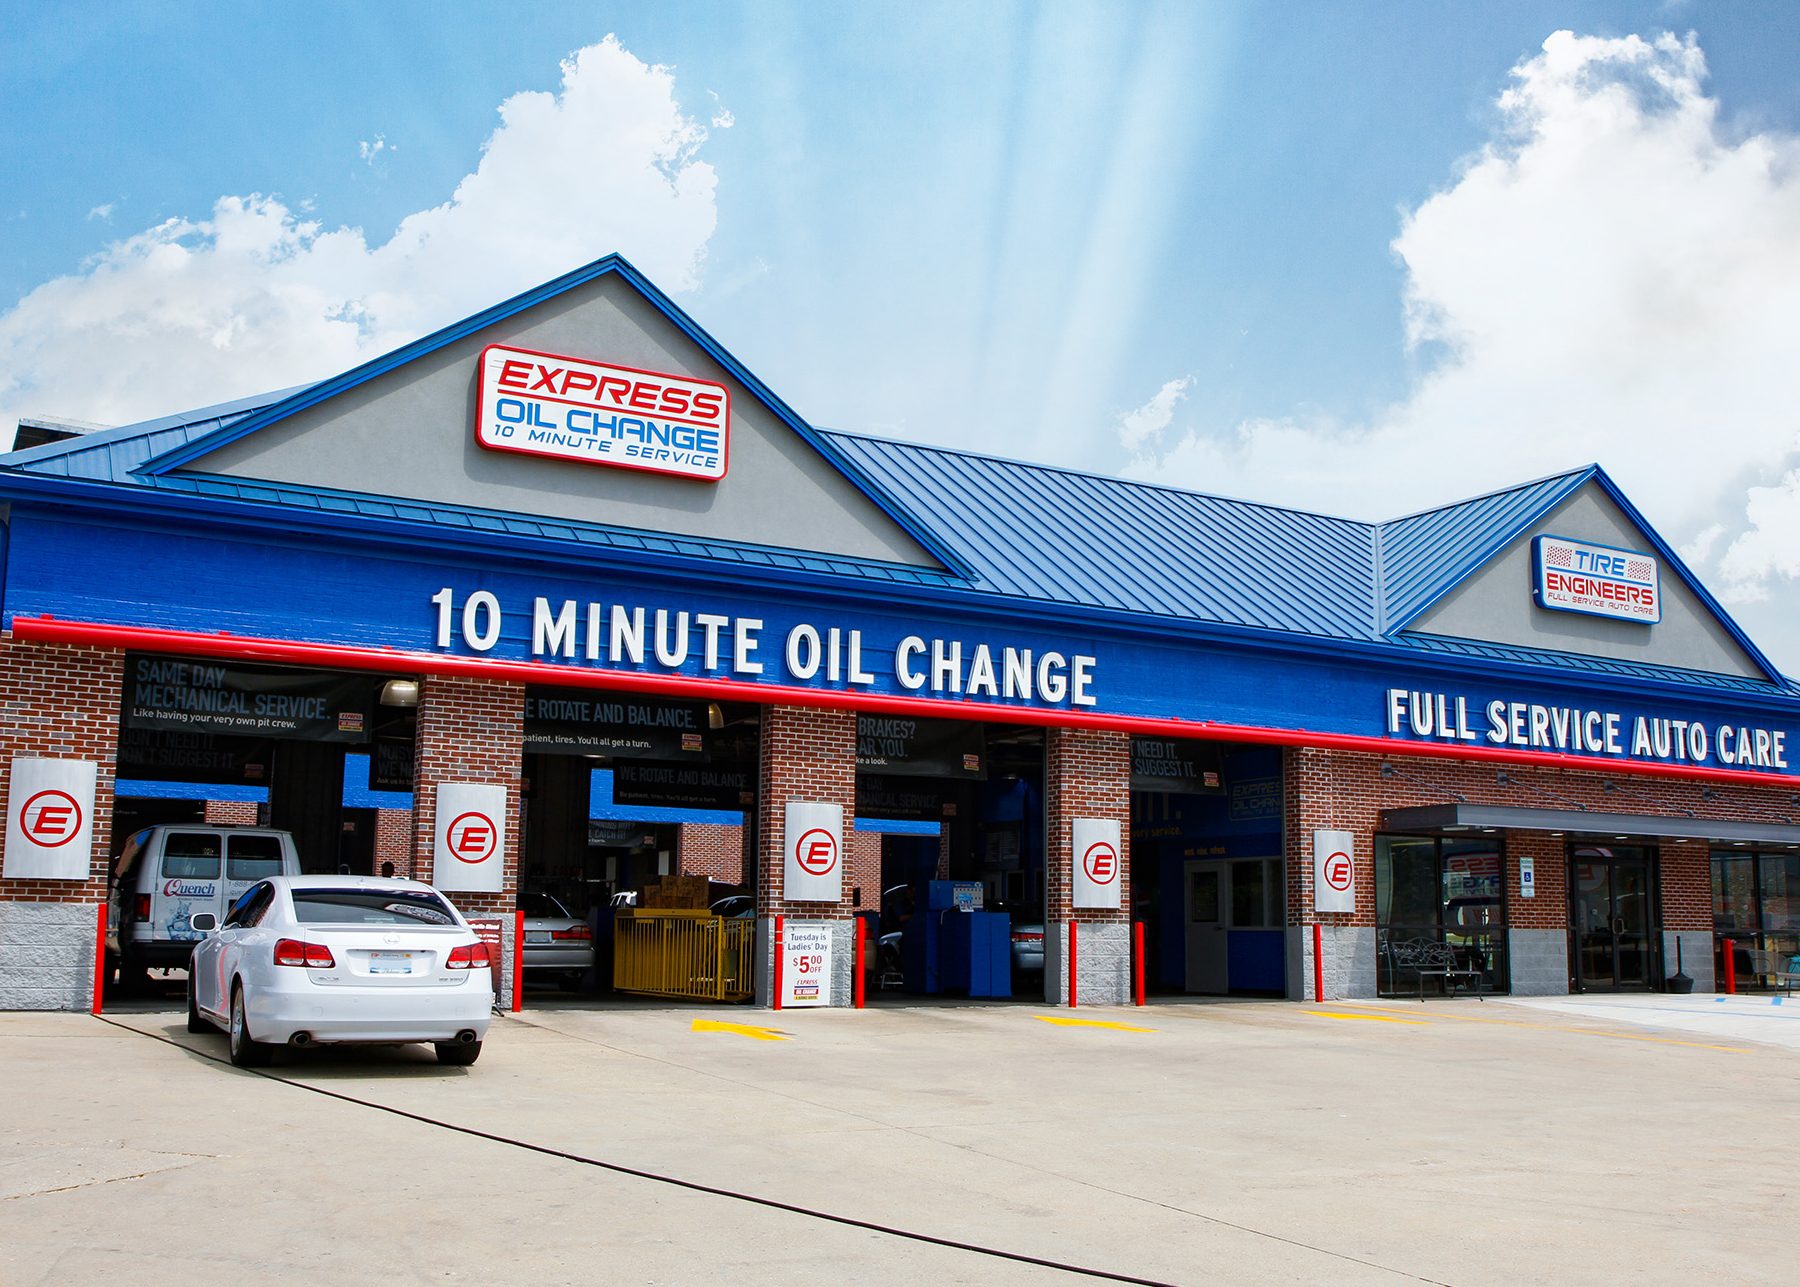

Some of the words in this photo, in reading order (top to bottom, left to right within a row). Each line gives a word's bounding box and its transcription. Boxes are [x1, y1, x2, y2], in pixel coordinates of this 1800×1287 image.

[497, 359, 723, 420] EXPRESS
[496, 398, 557, 430] OIL
[566, 409, 719, 454] CHANGE
[494, 424, 514, 438] 10
[528, 429, 612, 452] MINUTE
[625, 445, 718, 469] SERVICE
[1575, 550, 1626, 577] TIRE
[1546, 572, 1654, 605] ENGINEERS
[1548, 592, 1568, 602] FULL
[1572, 595, 1604, 608] SERVICE
[1608, 602, 1630, 612] AUTO
[1633, 606, 1653, 615] CARE
[432, 588, 501, 651] 10
[532, 597, 763, 674] MINUTE
[786, 623, 874, 684] OIL
[895, 636, 1097, 706] CHANGE
[136, 659, 187, 686] SAME
[192, 665, 227, 689] DAY
[134, 683, 250, 715] MECHANICAL
[254, 693, 331, 721] SERVICE.
[133, 708, 154, 718] Like
[157, 709, 188, 723] having
[190, 714, 211, 723] your
[214, 717, 234, 726] very
[236, 718, 256, 726] own
[258, 716, 270, 728] pit
[271, 720, 296, 729] crew.
[525, 700, 535, 718] E
[538, 700, 590, 722] ROTATE
[593, 703, 624, 724] AND
[628, 706, 697, 729] BALANCE.
[859, 717, 916, 739] BRAKES?
[1386, 688, 1476, 741] FULL
[1487, 699, 1622, 754] SERVICE
[1631, 716, 1708, 762] AUTO
[1715, 725, 1788, 769] CARE
[555, 734, 576, 745] tires.
[577, 735, 598, 746] You'll
[600, 736, 611, 746] all
[612, 739, 624, 750] get
[632, 738, 651, 748] turn.
[859, 737, 876, 755] AR
[878, 739, 908, 758] YOU.
[1135, 740, 1163, 758] NEED
[1166, 743, 1178, 760] IT.
[871, 757, 887, 766] look.
[1135, 758, 1181, 777] SUGGEST
[1183, 761, 1197, 777] IT.
[33, 807, 72, 835] E
[459, 828, 490, 852] E
[807, 842, 831, 865] E
[1092, 854, 1113, 876] E
[1331, 863, 1350, 883] E
[163, 878, 216, 898] Quench
[788, 943, 813, 951] Ladies'
[815, 943, 828, 952] Day
[791, 933, 819, 943] Tuesday
[821, 933, 826, 941] is
[810, 966, 821, 974] OFF
